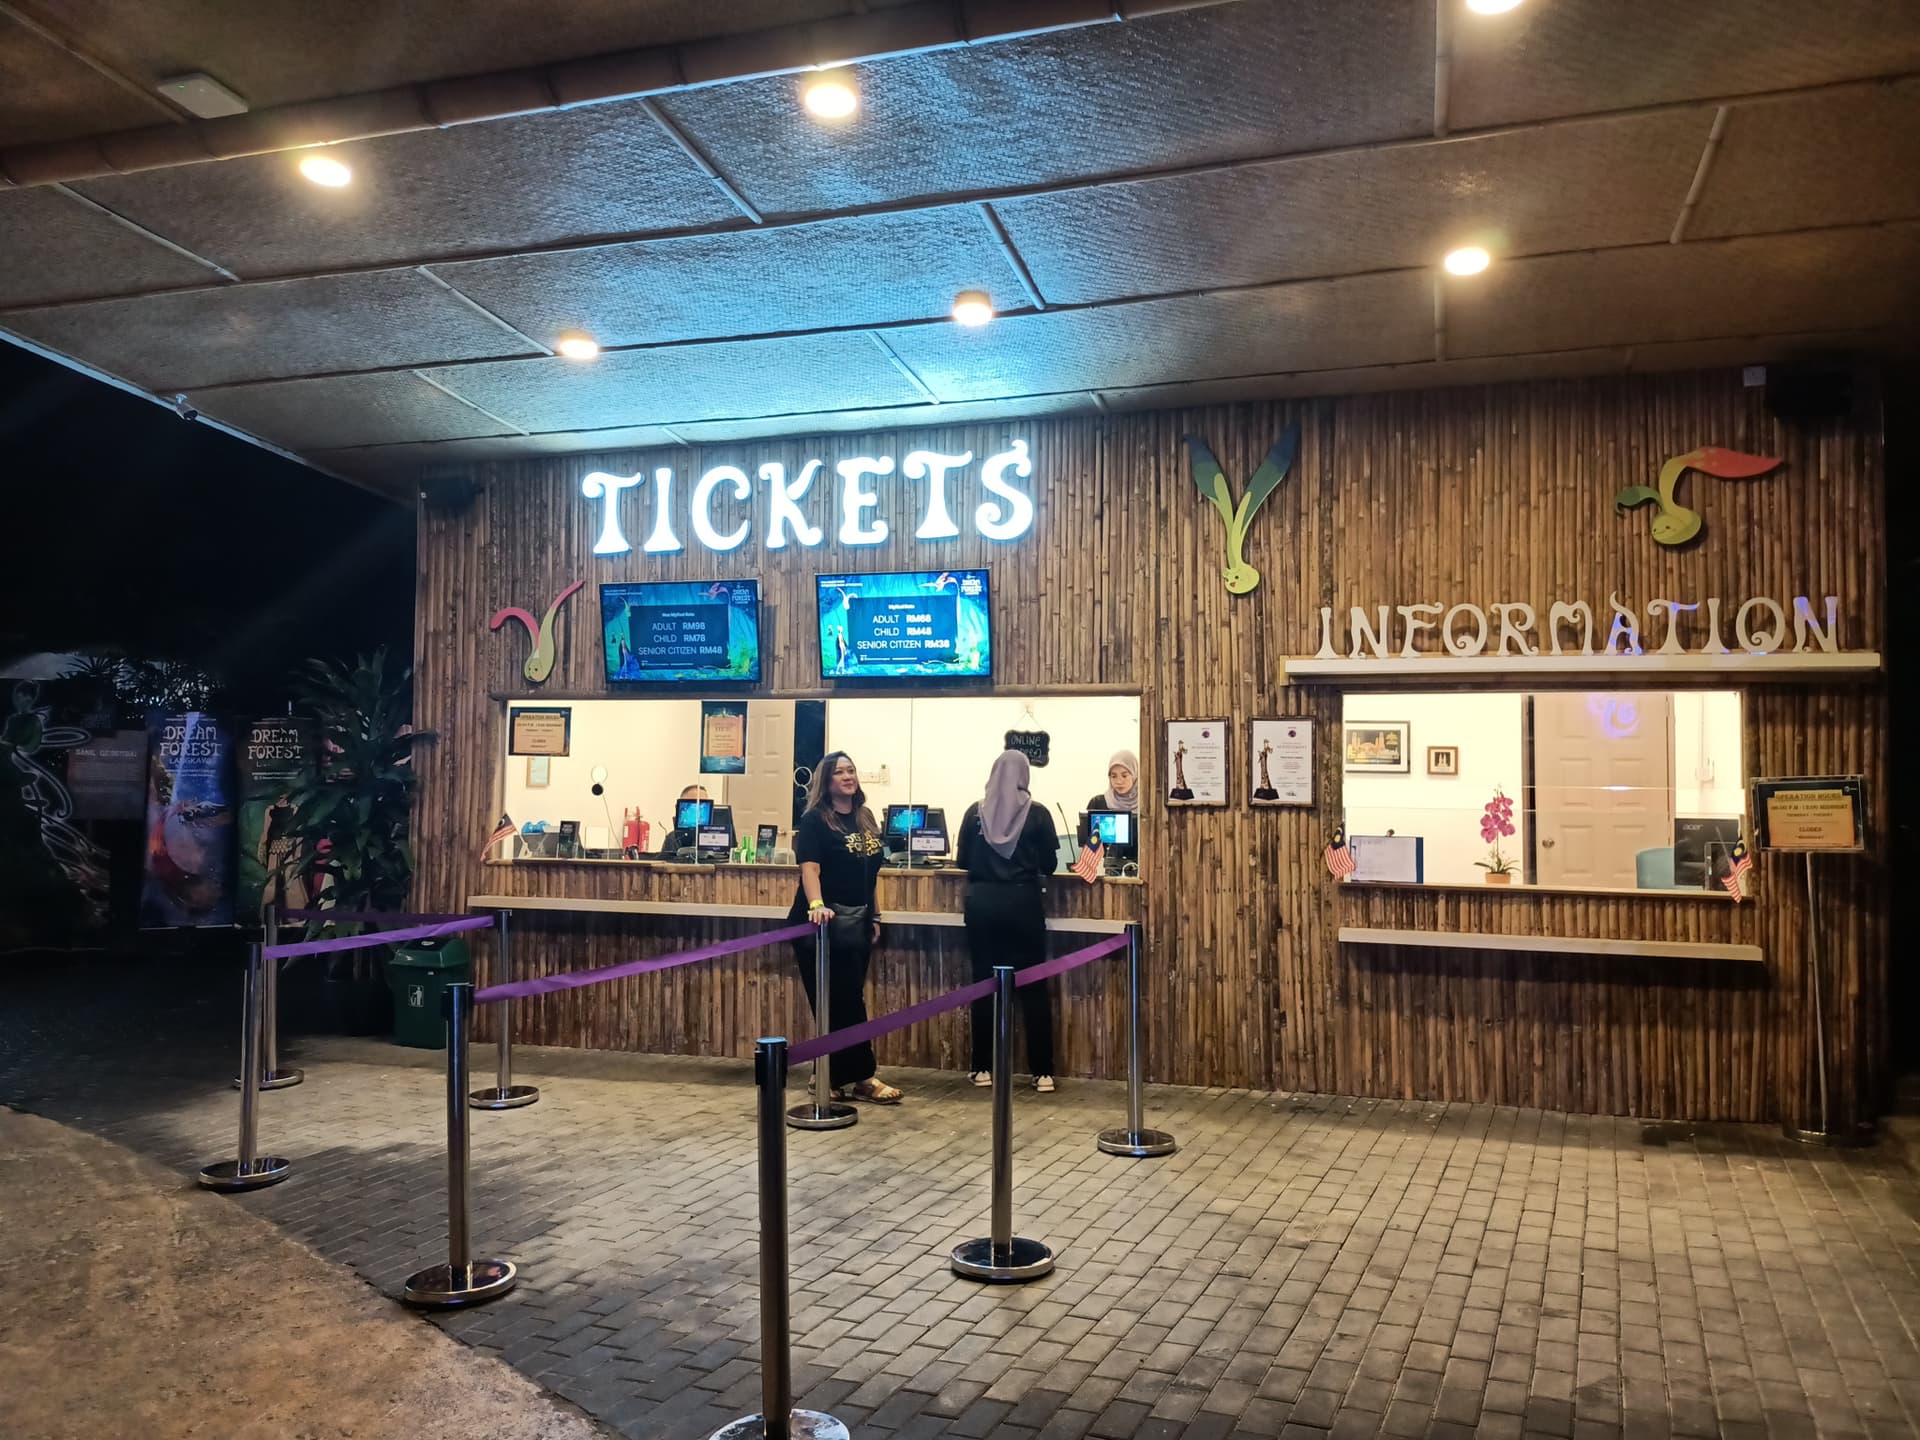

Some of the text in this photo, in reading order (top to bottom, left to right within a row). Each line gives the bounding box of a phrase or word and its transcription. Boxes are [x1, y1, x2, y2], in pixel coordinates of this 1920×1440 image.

[581, 439, 1035, 555] TICKETS
[872, 615, 900, 624] ADULT
[1313, 590, 1839, 660] INFORMATION
[652, 622, 677, 631] ADULT
[873, 627, 900, 636] CHILD
[653, 634, 677, 643] CHILD
[857, 640, 888, 649] SENIOR
[889, 639, 921, 648] CITIZEN
[638, 647, 667, 656] SENIOR
[667, 646, 697, 655] CITIZEN
[163, 724, 217, 741] DREAM
[251, 728, 298, 744] DREAM
[159, 741, 223, 757] FOREST
[247, 745, 304, 760] FOREST
